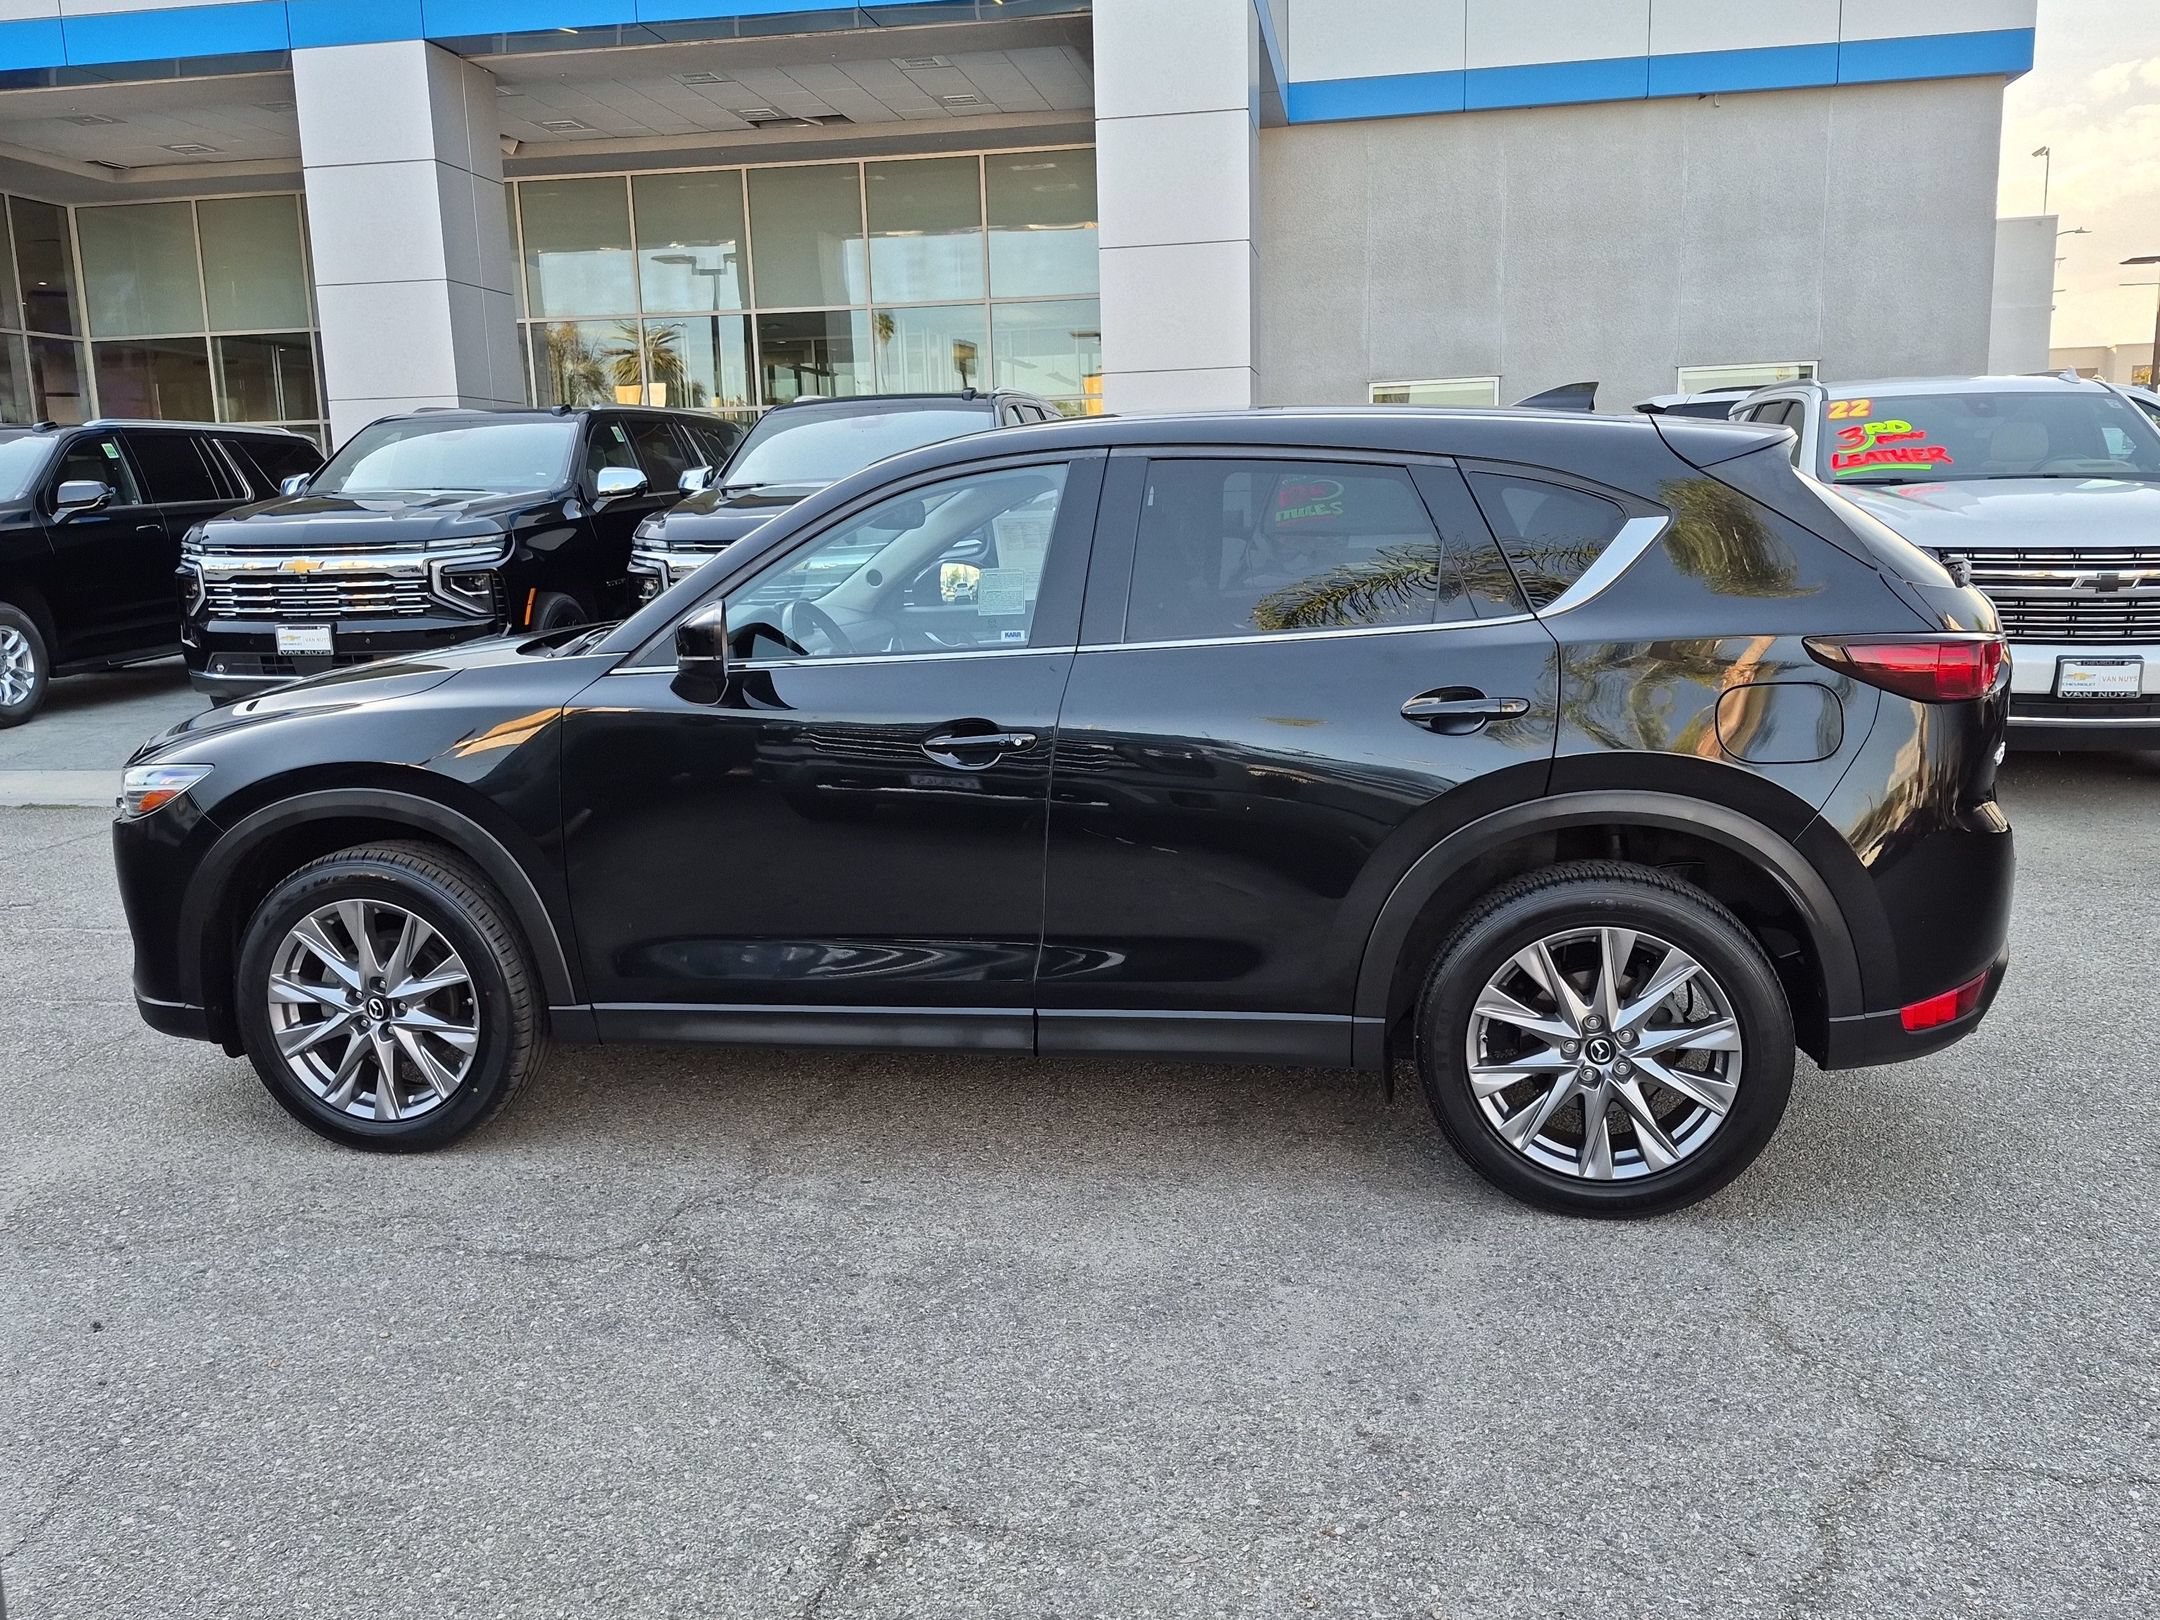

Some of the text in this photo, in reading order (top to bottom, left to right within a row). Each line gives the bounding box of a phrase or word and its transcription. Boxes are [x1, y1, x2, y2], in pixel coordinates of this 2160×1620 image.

[1828, 398, 1872, 420] 22
[1830, 445, 1954, 471] LEATHER
[2102, 675, 2117, 683] VAN
